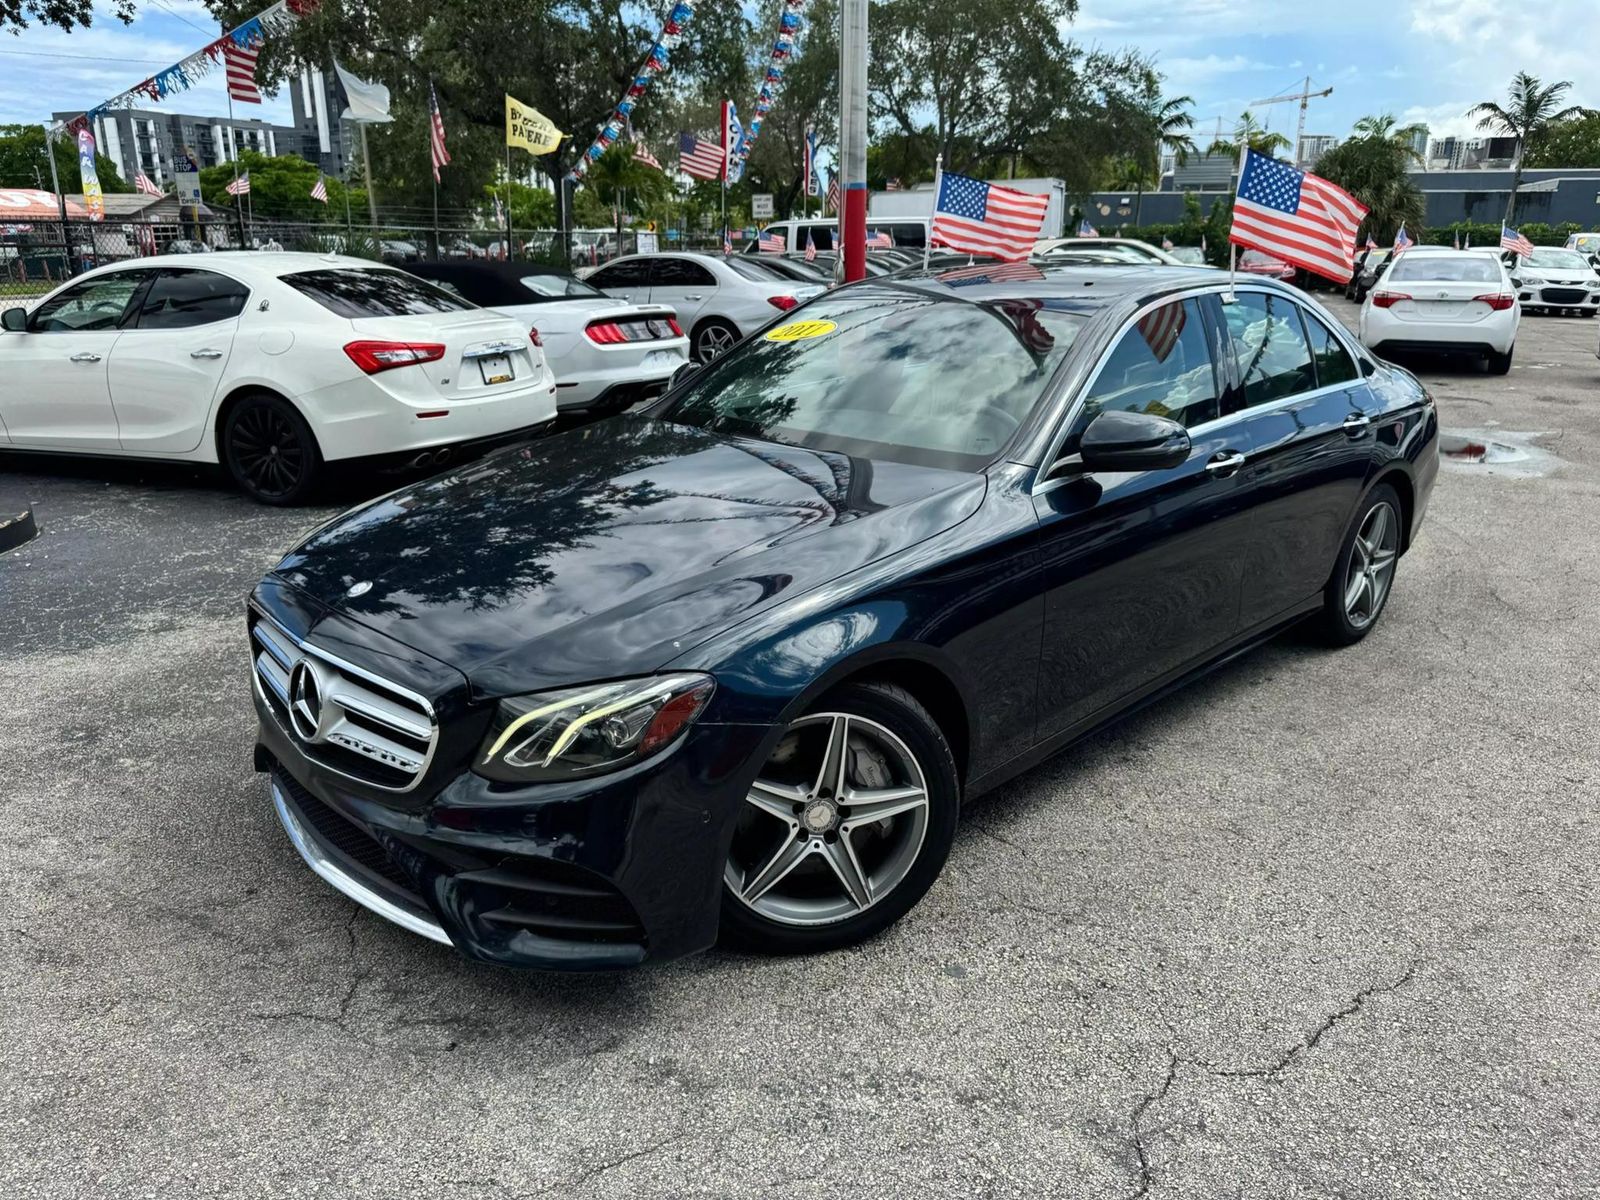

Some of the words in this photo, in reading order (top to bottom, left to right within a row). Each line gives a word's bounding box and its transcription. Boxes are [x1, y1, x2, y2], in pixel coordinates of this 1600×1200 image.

[173, 156, 188, 164] BUS
[174, 163, 192, 172] STOP
[772, 323, 829, 338] 2017
